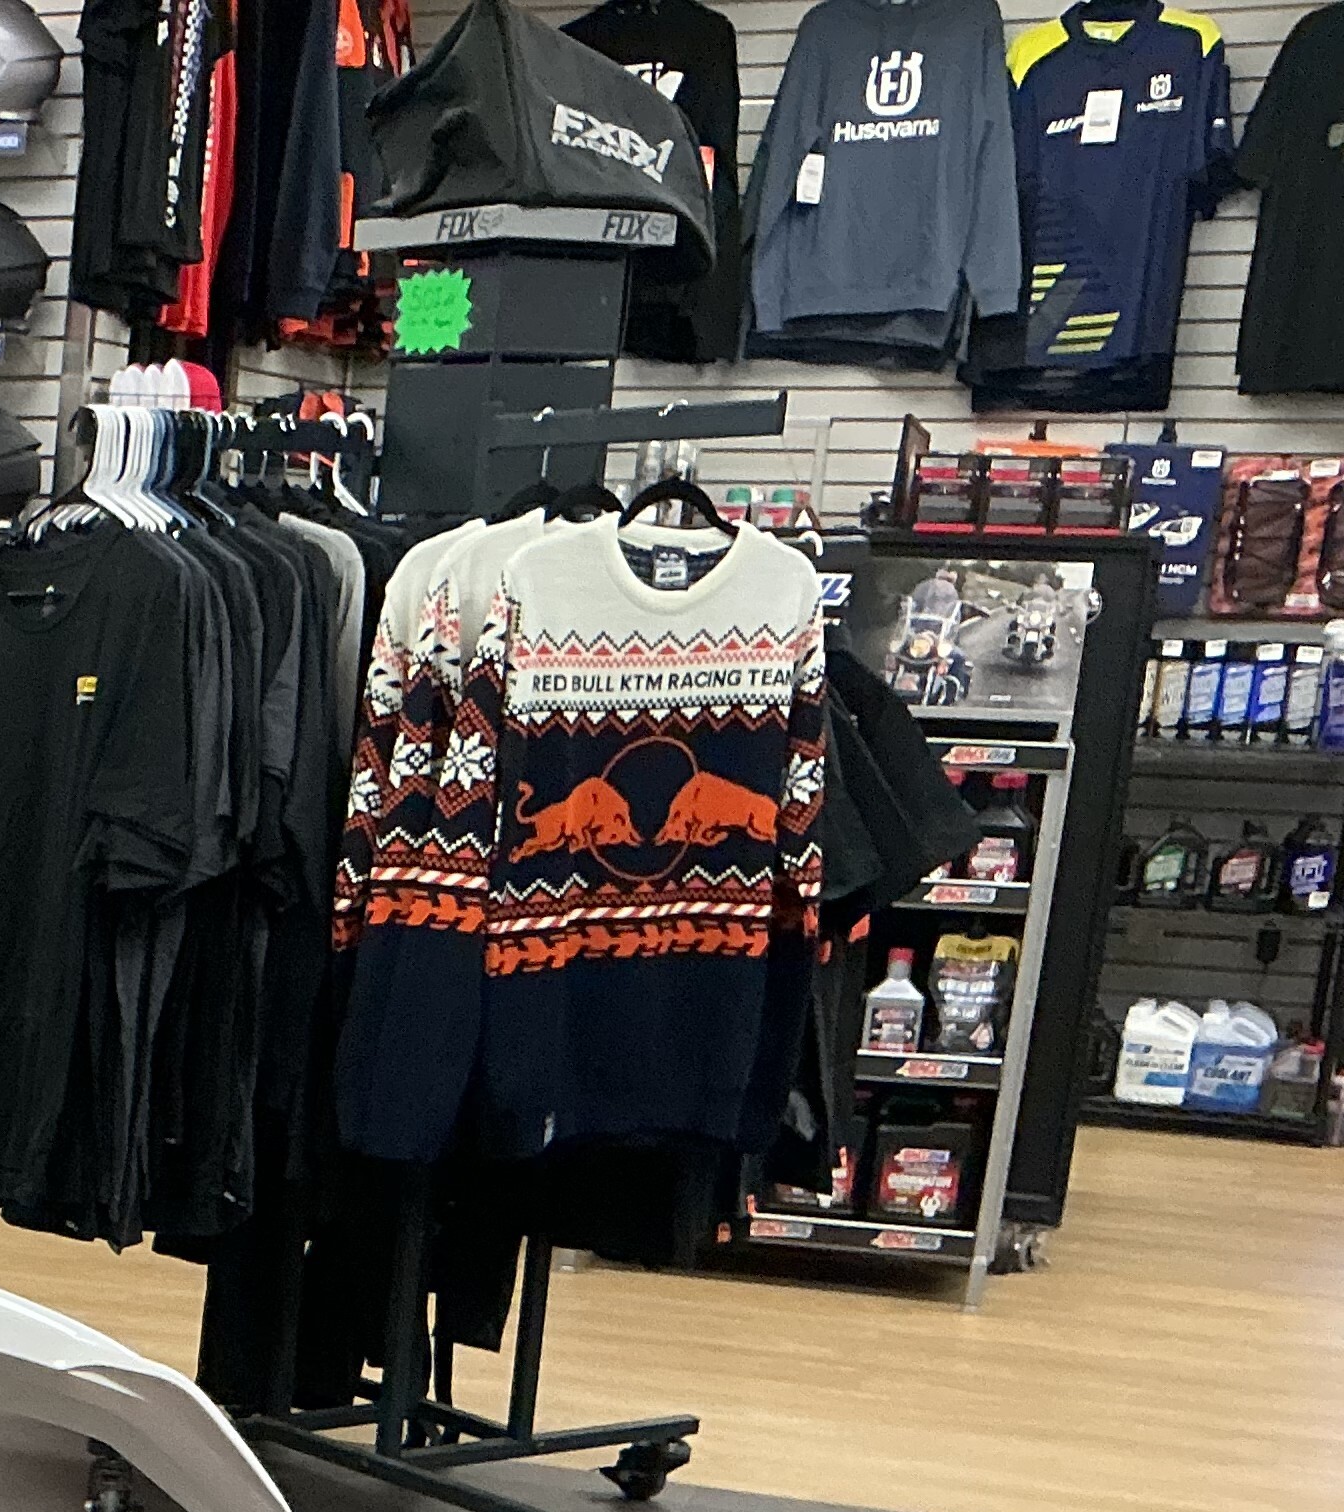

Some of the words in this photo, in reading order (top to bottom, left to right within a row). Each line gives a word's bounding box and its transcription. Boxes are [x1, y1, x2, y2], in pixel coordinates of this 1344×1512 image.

[833, 119, 940, 143] Husqvarna
[436, 212, 479, 241] FOX
[603, 211, 649, 240] FOX
[533, 672, 567, 692] RED
[572, 671, 615, 692] BULL
[620, 670, 663, 691] KTM
[668, 668, 742, 689] RACING
